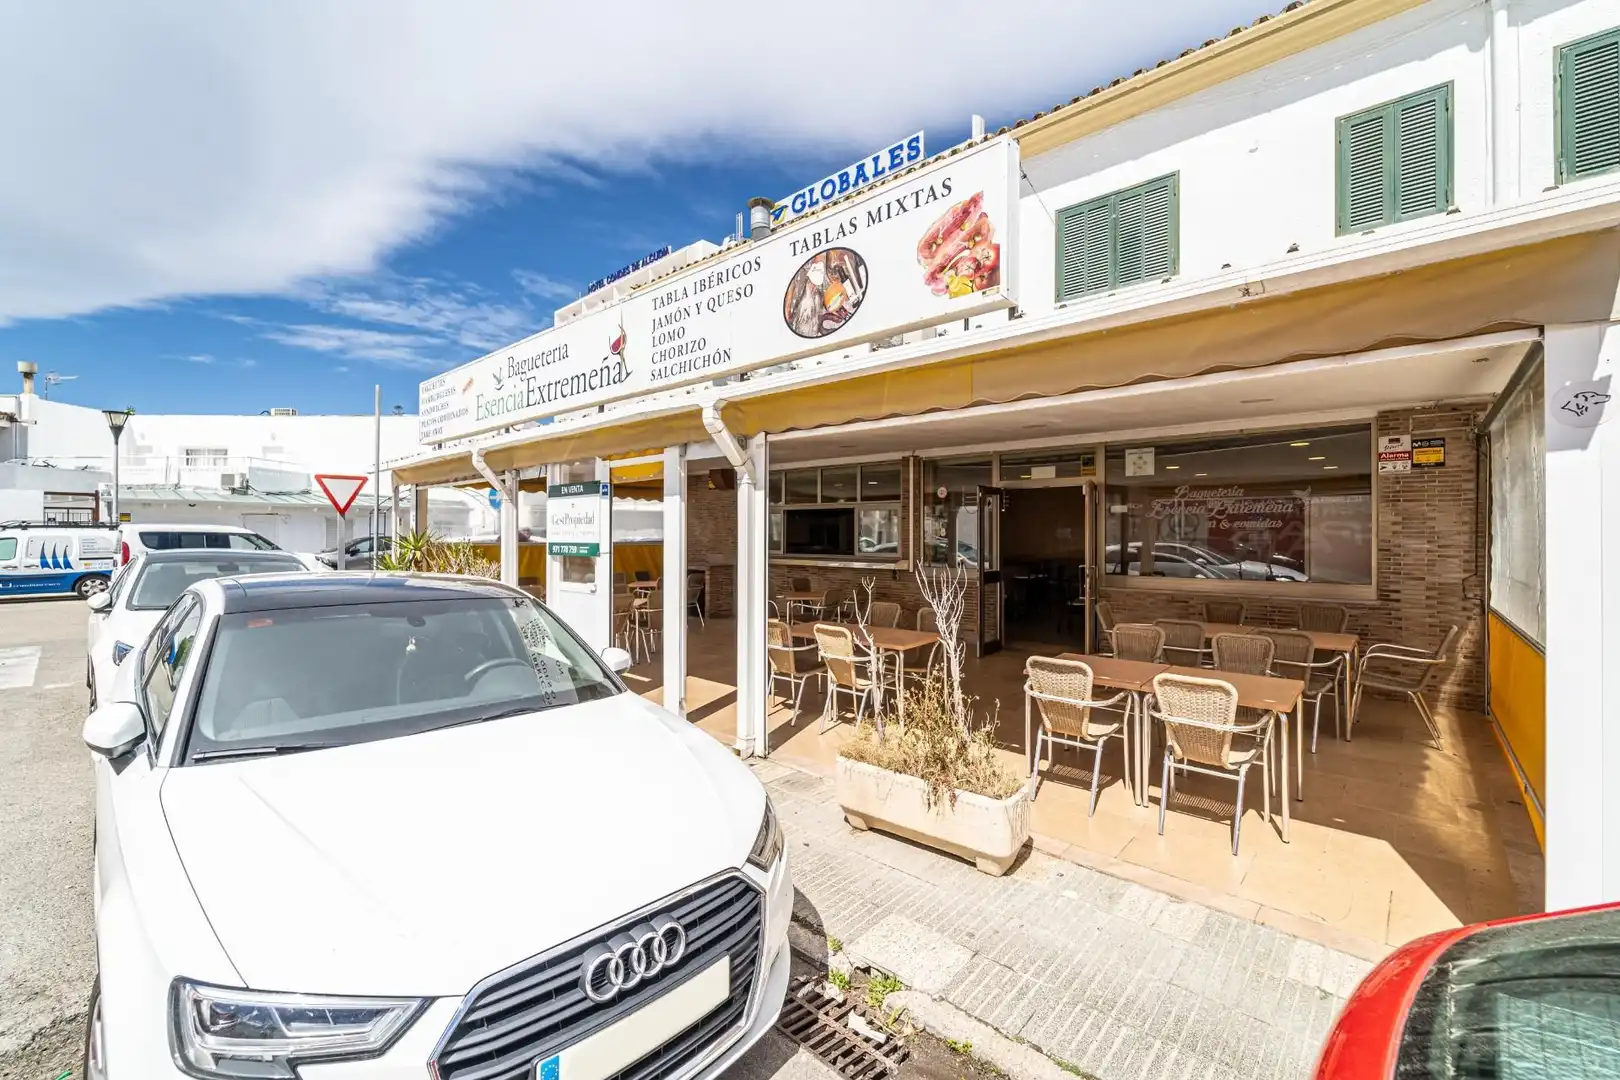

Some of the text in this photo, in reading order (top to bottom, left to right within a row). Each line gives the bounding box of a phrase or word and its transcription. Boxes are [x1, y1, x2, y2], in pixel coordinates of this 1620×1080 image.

[791, 135, 921, 214] GLOBALES
[789, 177, 952, 257] TABLAS MIXTAS
[587, 278, 606, 294] HOTEL
[631, 260, 641, 273] DE
[651, 256, 761, 311] TABLA IBÉRICOS
[651, 283, 754, 334] JAMÓN Y QUESO
[651, 337, 706, 364] CHORIZO
[652, 326, 685, 348] LOMO
[650, 347, 732, 381] SALCHICHÓN
[561, 484, 584, 494] EN VENTA
[551, 510, 595, 528] GestPropiedad
[1145, 499, 1206, 519] Esencia
[1234, 518, 1283, 528] comidas
